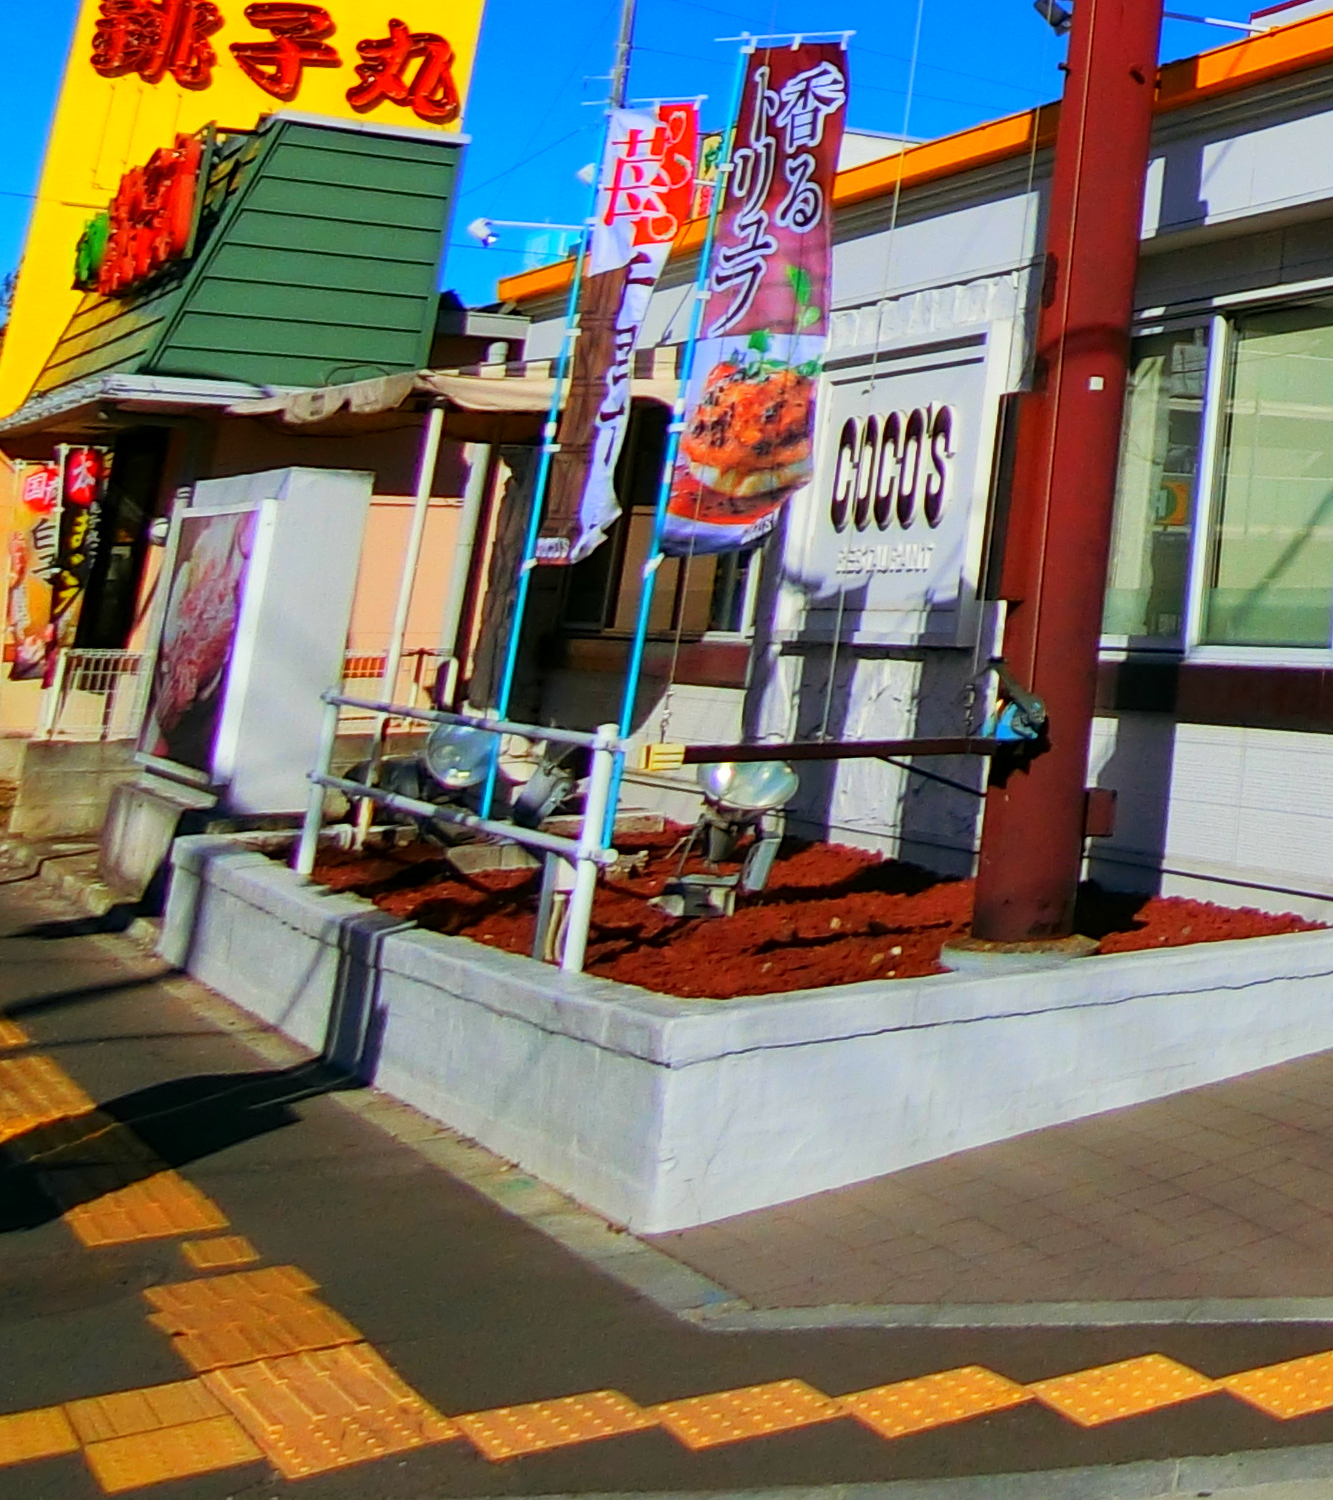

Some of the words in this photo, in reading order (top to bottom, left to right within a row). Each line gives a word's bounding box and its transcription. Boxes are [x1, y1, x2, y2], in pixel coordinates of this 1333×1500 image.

[708, 65, 779, 338] トリュフ
[776, 61, 846, 233] 香る
[830, 399, 957, 535] COCO'S
